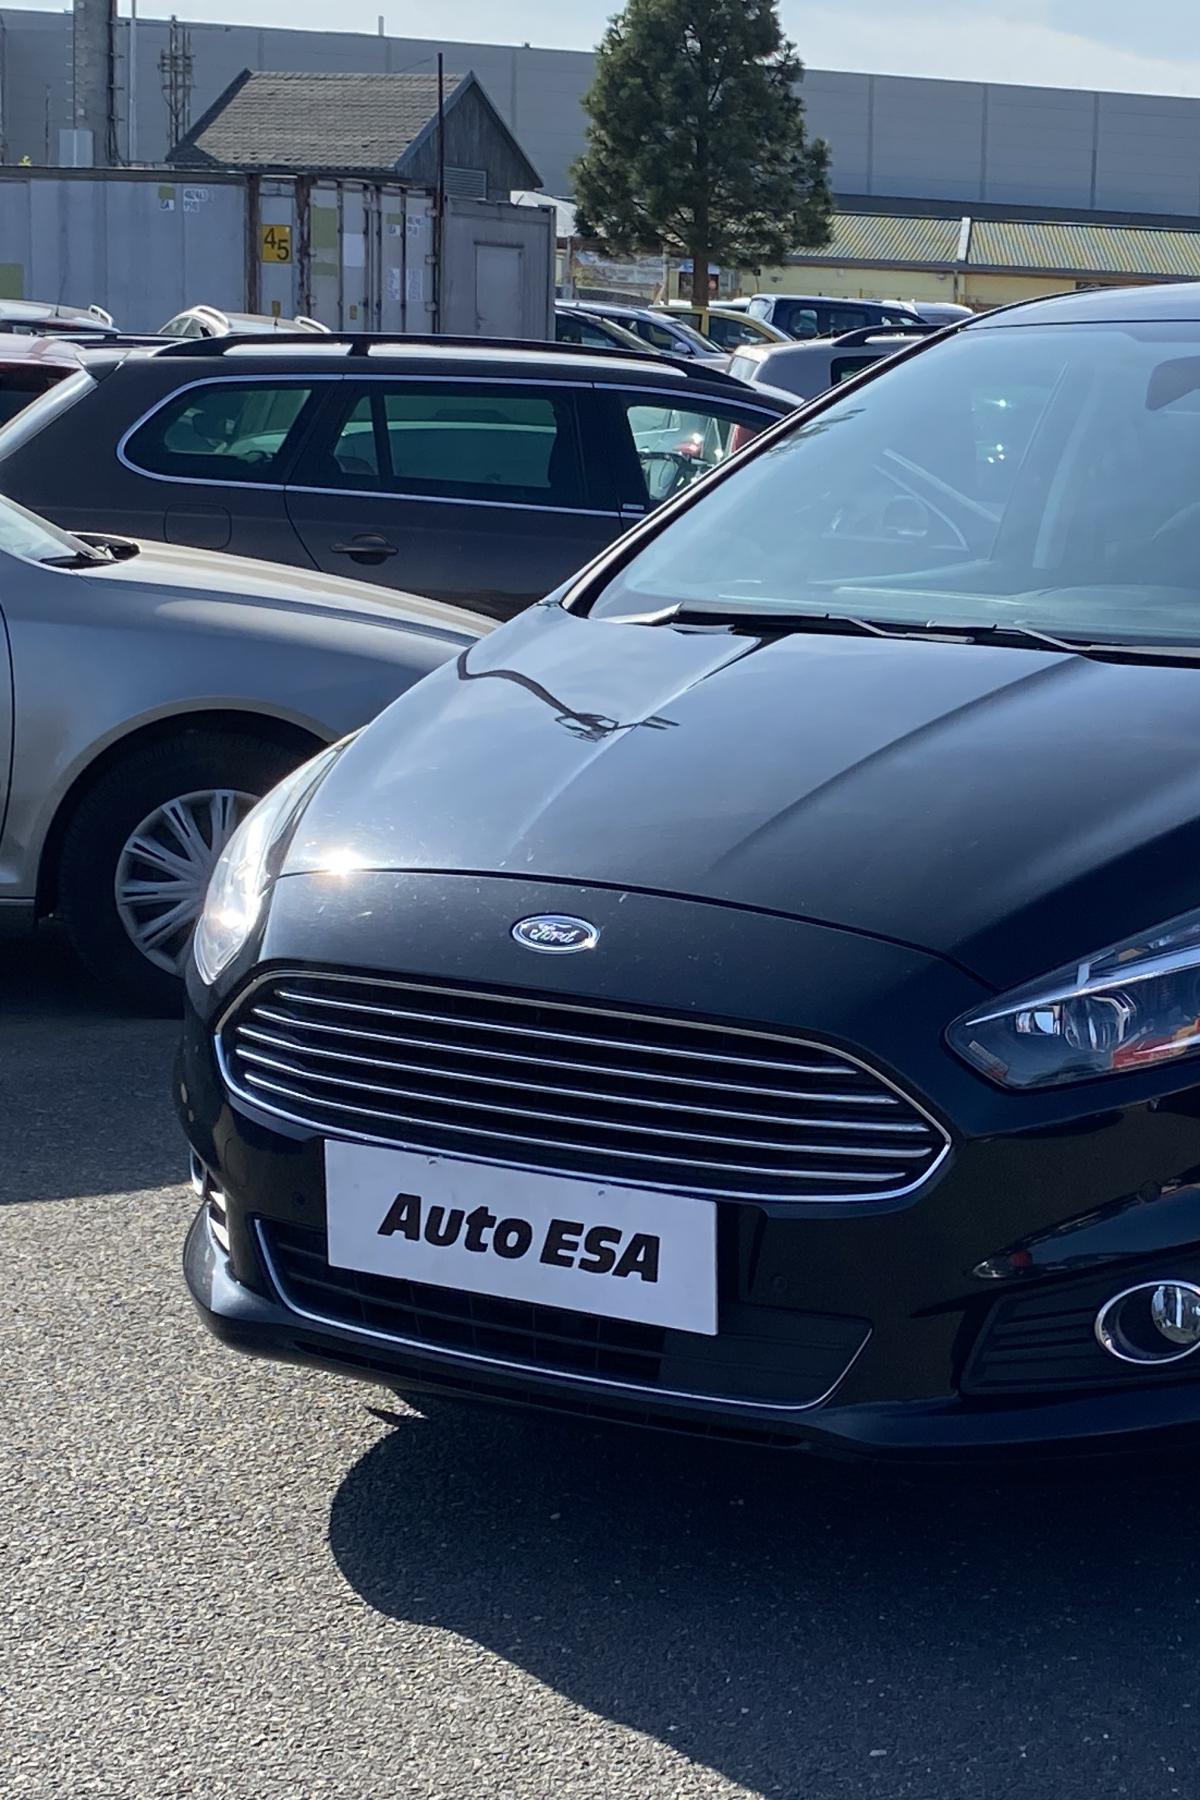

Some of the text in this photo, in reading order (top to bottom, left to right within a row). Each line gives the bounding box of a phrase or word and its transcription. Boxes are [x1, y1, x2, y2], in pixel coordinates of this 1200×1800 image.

[529, 922, 580, 943] Ford
[377, 1192, 661, 1283] Auto ESA
